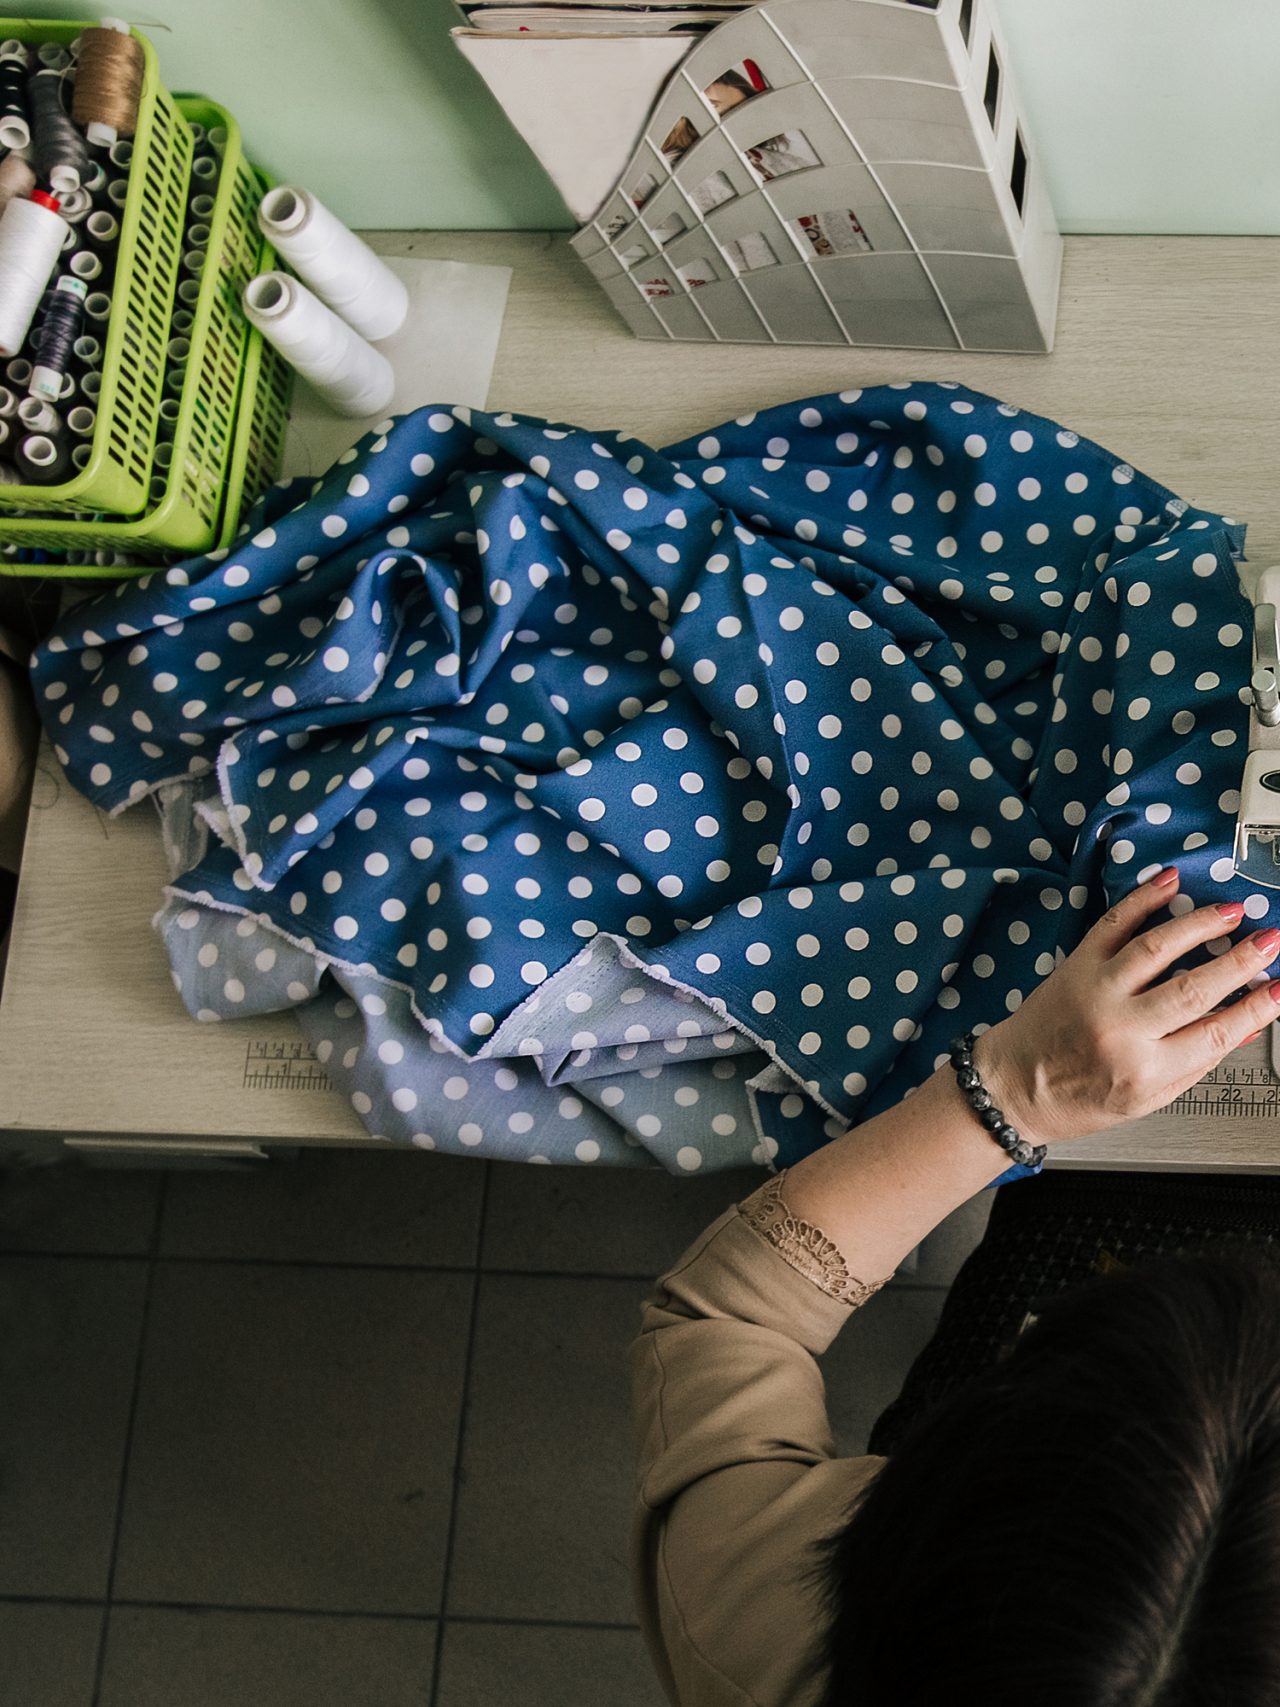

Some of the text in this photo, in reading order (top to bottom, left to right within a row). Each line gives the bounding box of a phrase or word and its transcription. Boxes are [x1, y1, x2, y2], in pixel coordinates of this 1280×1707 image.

[1226, 1073, 1232, 1082] 6
[1262, 1074, 1269, 1083] 8
[1221, 1089, 1241, 1101] 22
